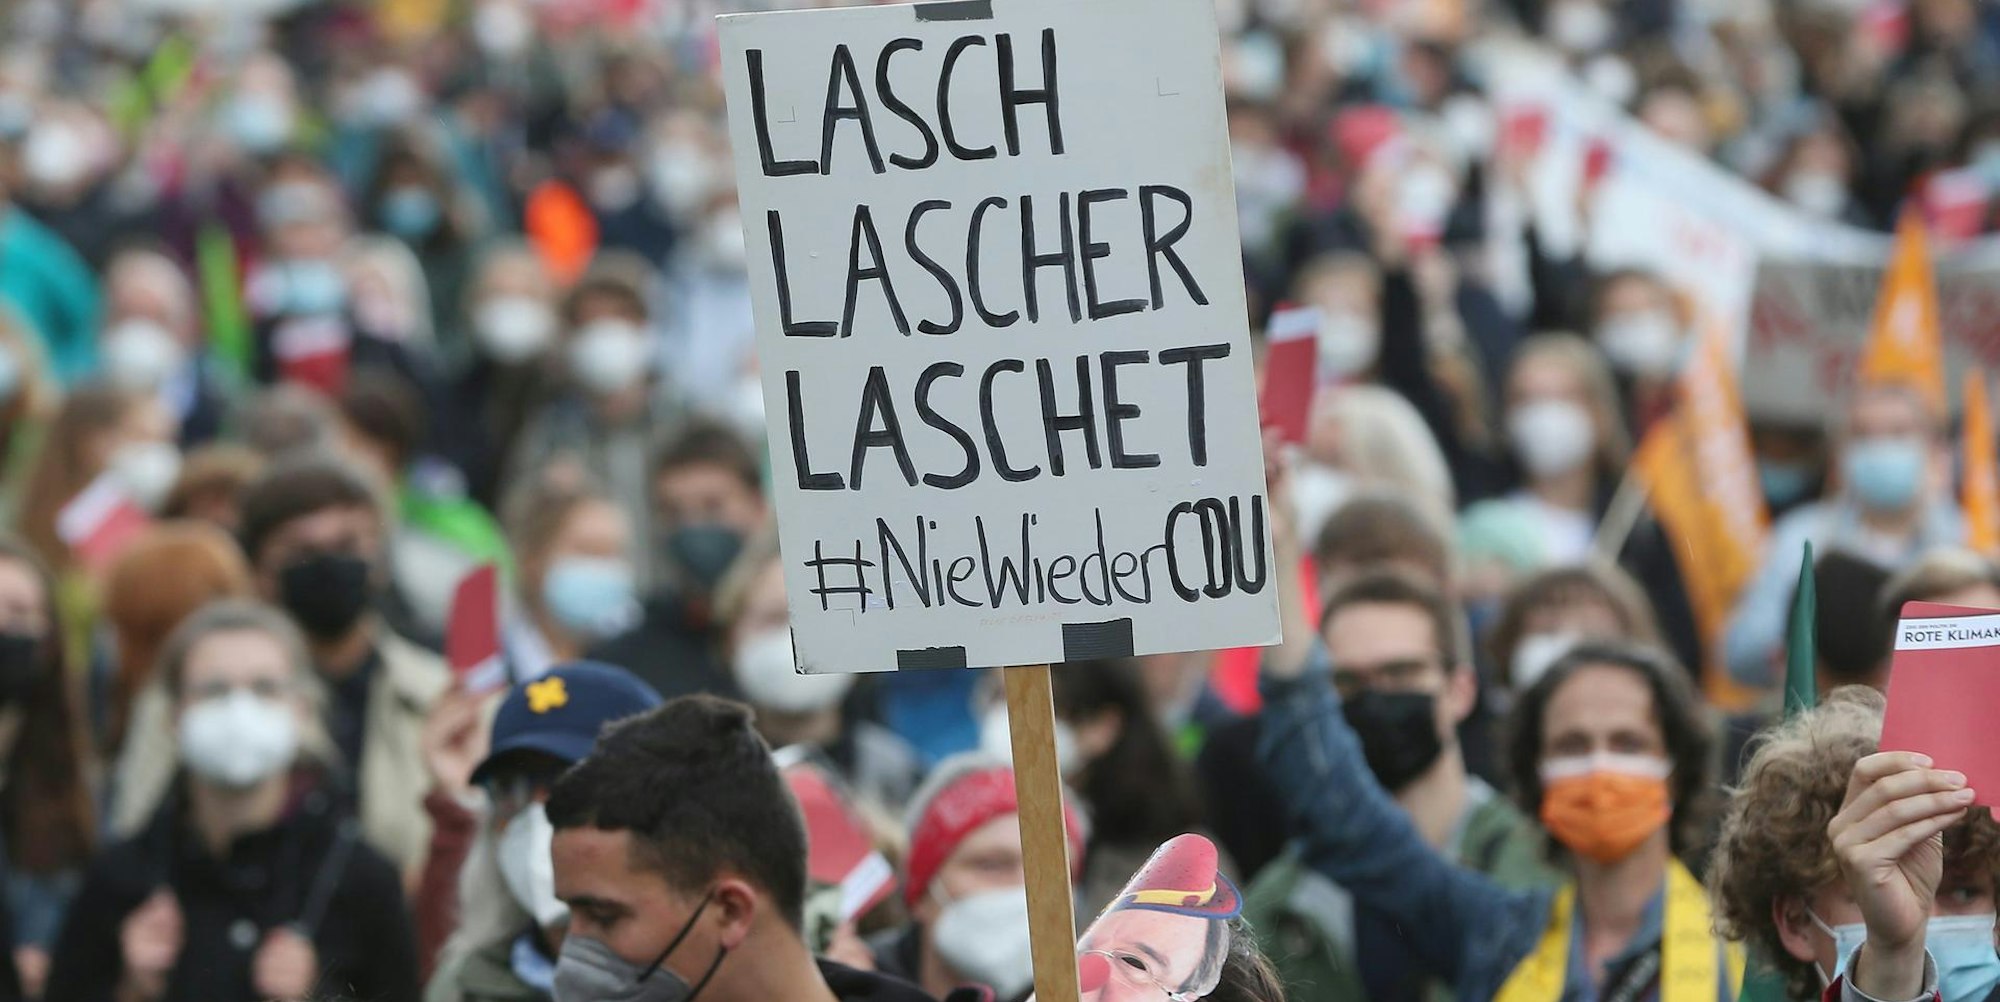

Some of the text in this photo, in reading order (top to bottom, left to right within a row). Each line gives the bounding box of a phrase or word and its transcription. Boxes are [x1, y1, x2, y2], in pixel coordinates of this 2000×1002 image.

[746, 28, 1064, 176] LASCH
[768, 185, 1209, 338] LASCHER
[786, 343, 1230, 490] LASCHET
[804, 495, 1266, 613] #NieWiederCDU
[1904, 631, 1943, 642] ROTE
